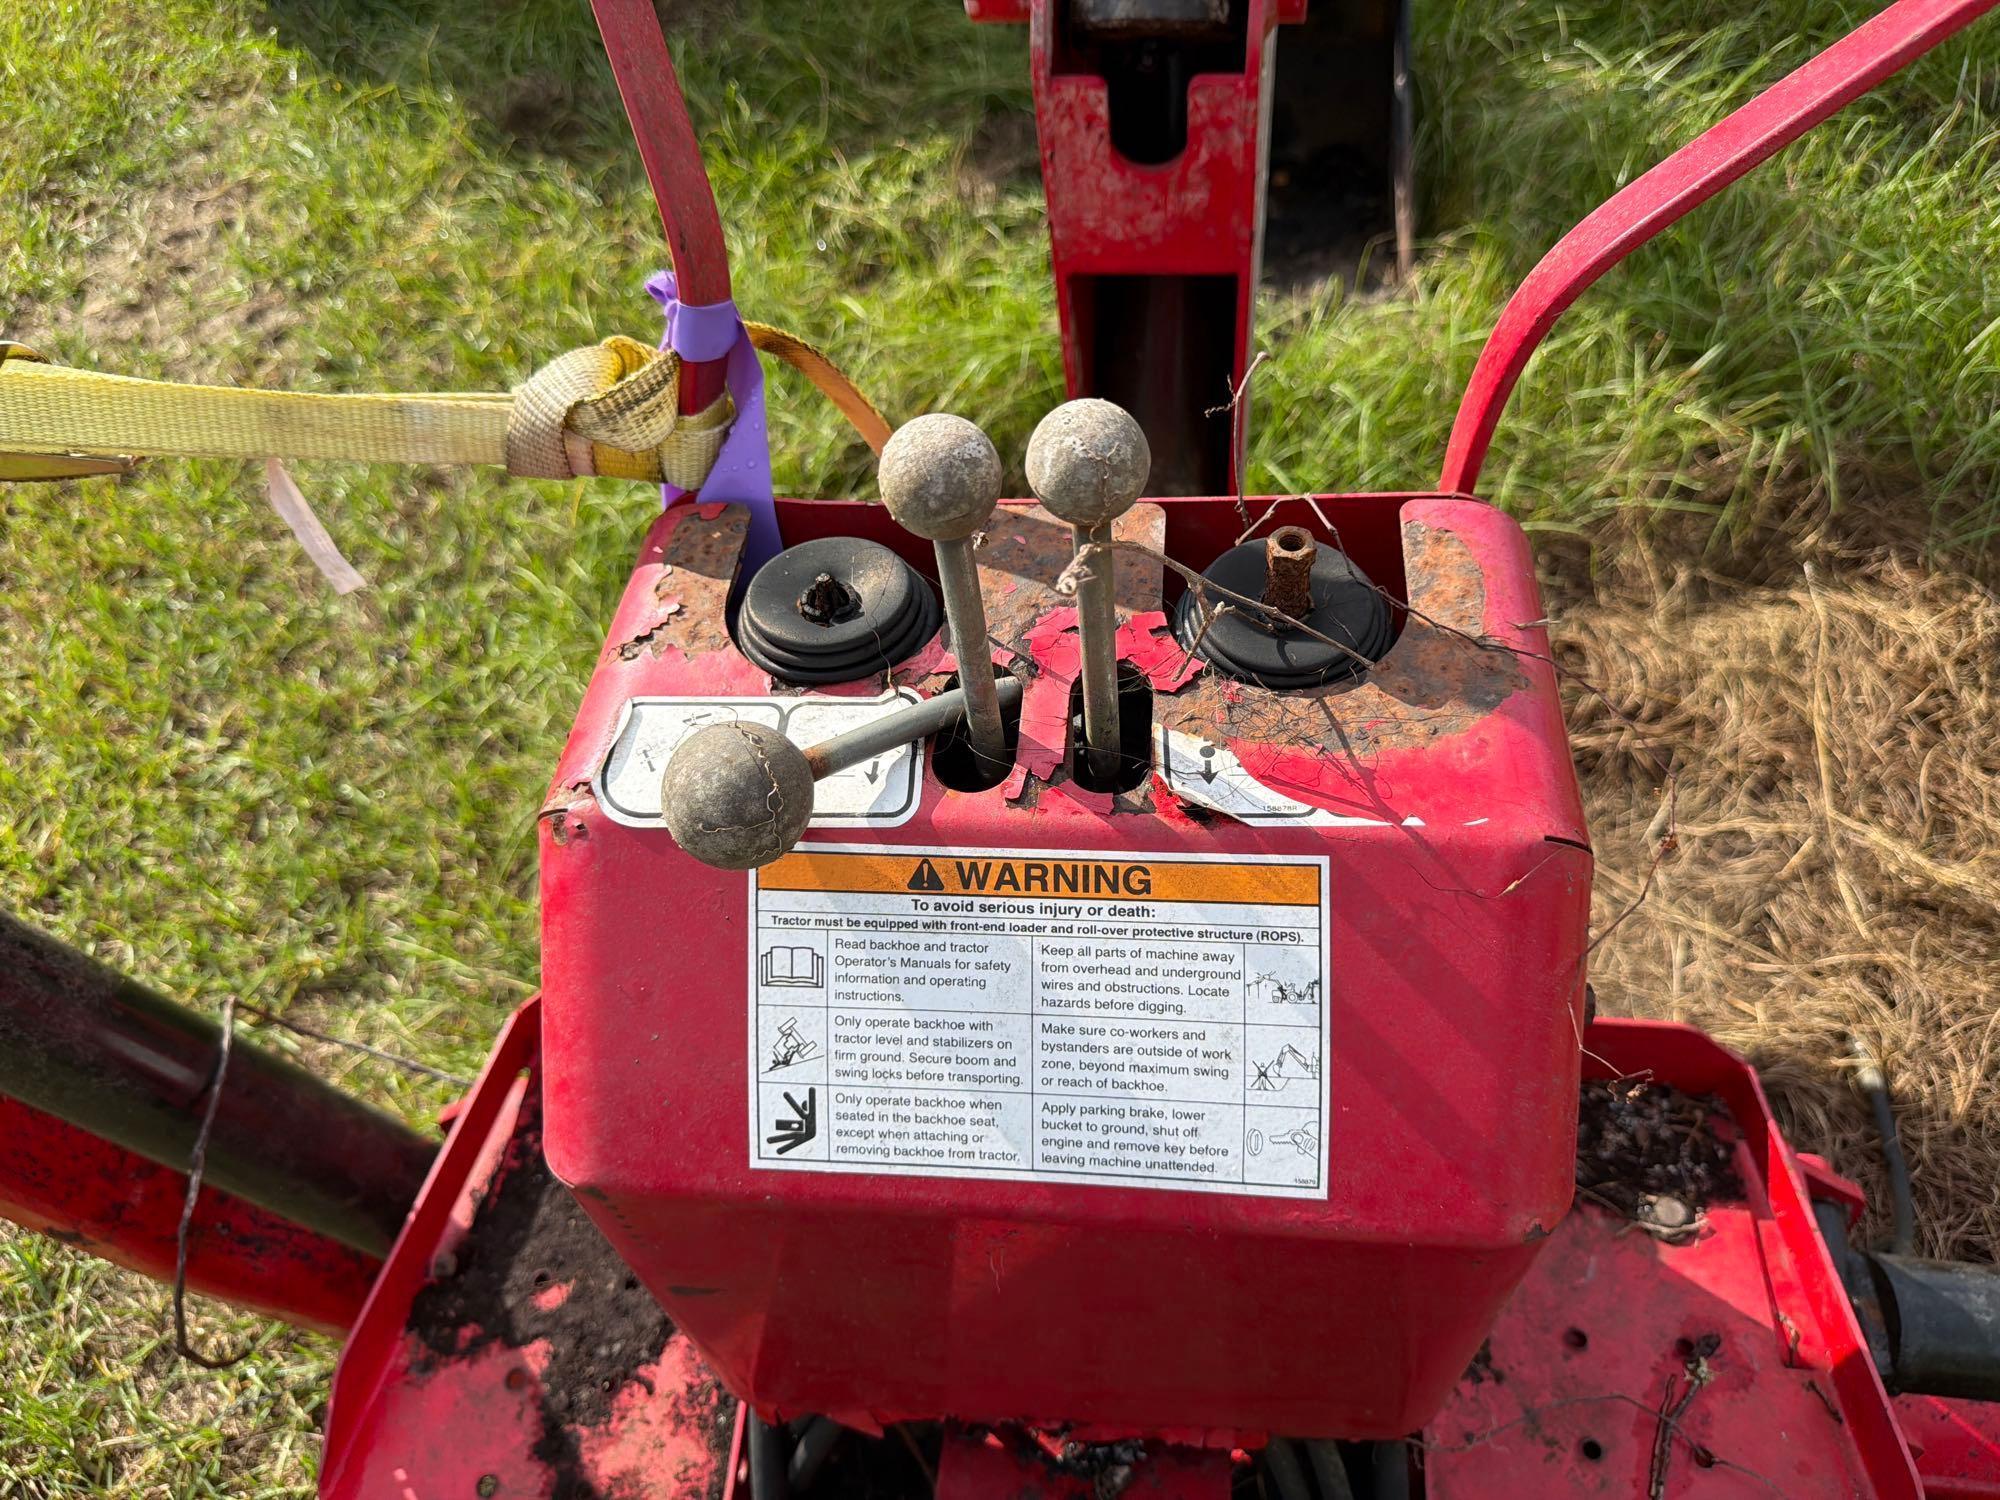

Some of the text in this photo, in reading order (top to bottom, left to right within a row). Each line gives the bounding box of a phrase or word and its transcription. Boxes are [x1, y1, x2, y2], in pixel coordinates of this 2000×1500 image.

[955, 862, 1150, 894] WARNING
[911, 898, 1155, 918] To avoid serious injury or death:
[771, 915, 1304, 944] Tractor must be equipped with front-end loader and roll-over protective structure (ROPS).
[835, 938, 988, 953] Read backhoe and tractor
[1041, 944, 1234, 965] Keep all parts of machine away
[834, 955, 1010, 973] Operator's Manuals for safety
[1041, 961, 1242, 981] from overhead and underground
[835, 972, 985, 990] information and operating
[1041, 981, 1229, 997] wires and obstructions. Locate
[834, 989, 904, 1002] instructions.
[1041, 996, 1186, 1015] hazards before digging.
[834, 1015, 992, 1031] Only operate backhoe with
[1041, 1022, 1205, 1040] Make sure co-workers and
[834, 1033, 1011, 1049] tractor level and stabilizers on
[1041, 1040, 1231, 1060] bystanders are outside of work
[834, 1049, 1015, 1067] firm ground. Secure boom and
[835, 1068, 1023, 1087] swing locks before transporting.
[1041, 1059, 1228, 1080] zone, beyond maximum swing
[1041, 1077, 1168, 1091] or reach of backhoe.
[835, 1092, 1001, 1110] Only operate backhoe when
[835, 1110, 998, 1128] seated in the backhoe seat,
[1041, 1101, 1205, 1120] Apply parking brake, lower
[836, 1128, 984, 1145] except when attaching or
[1041, 1118, 1198, 1137] bucket to ground, shut off
[836, 1144, 1020, 1161] removing backhoe from tractor.
[1041, 1137, 1228, 1156] engine and remove key before
[1042, 1152, 1218, 1172] leaving machine unattended.
